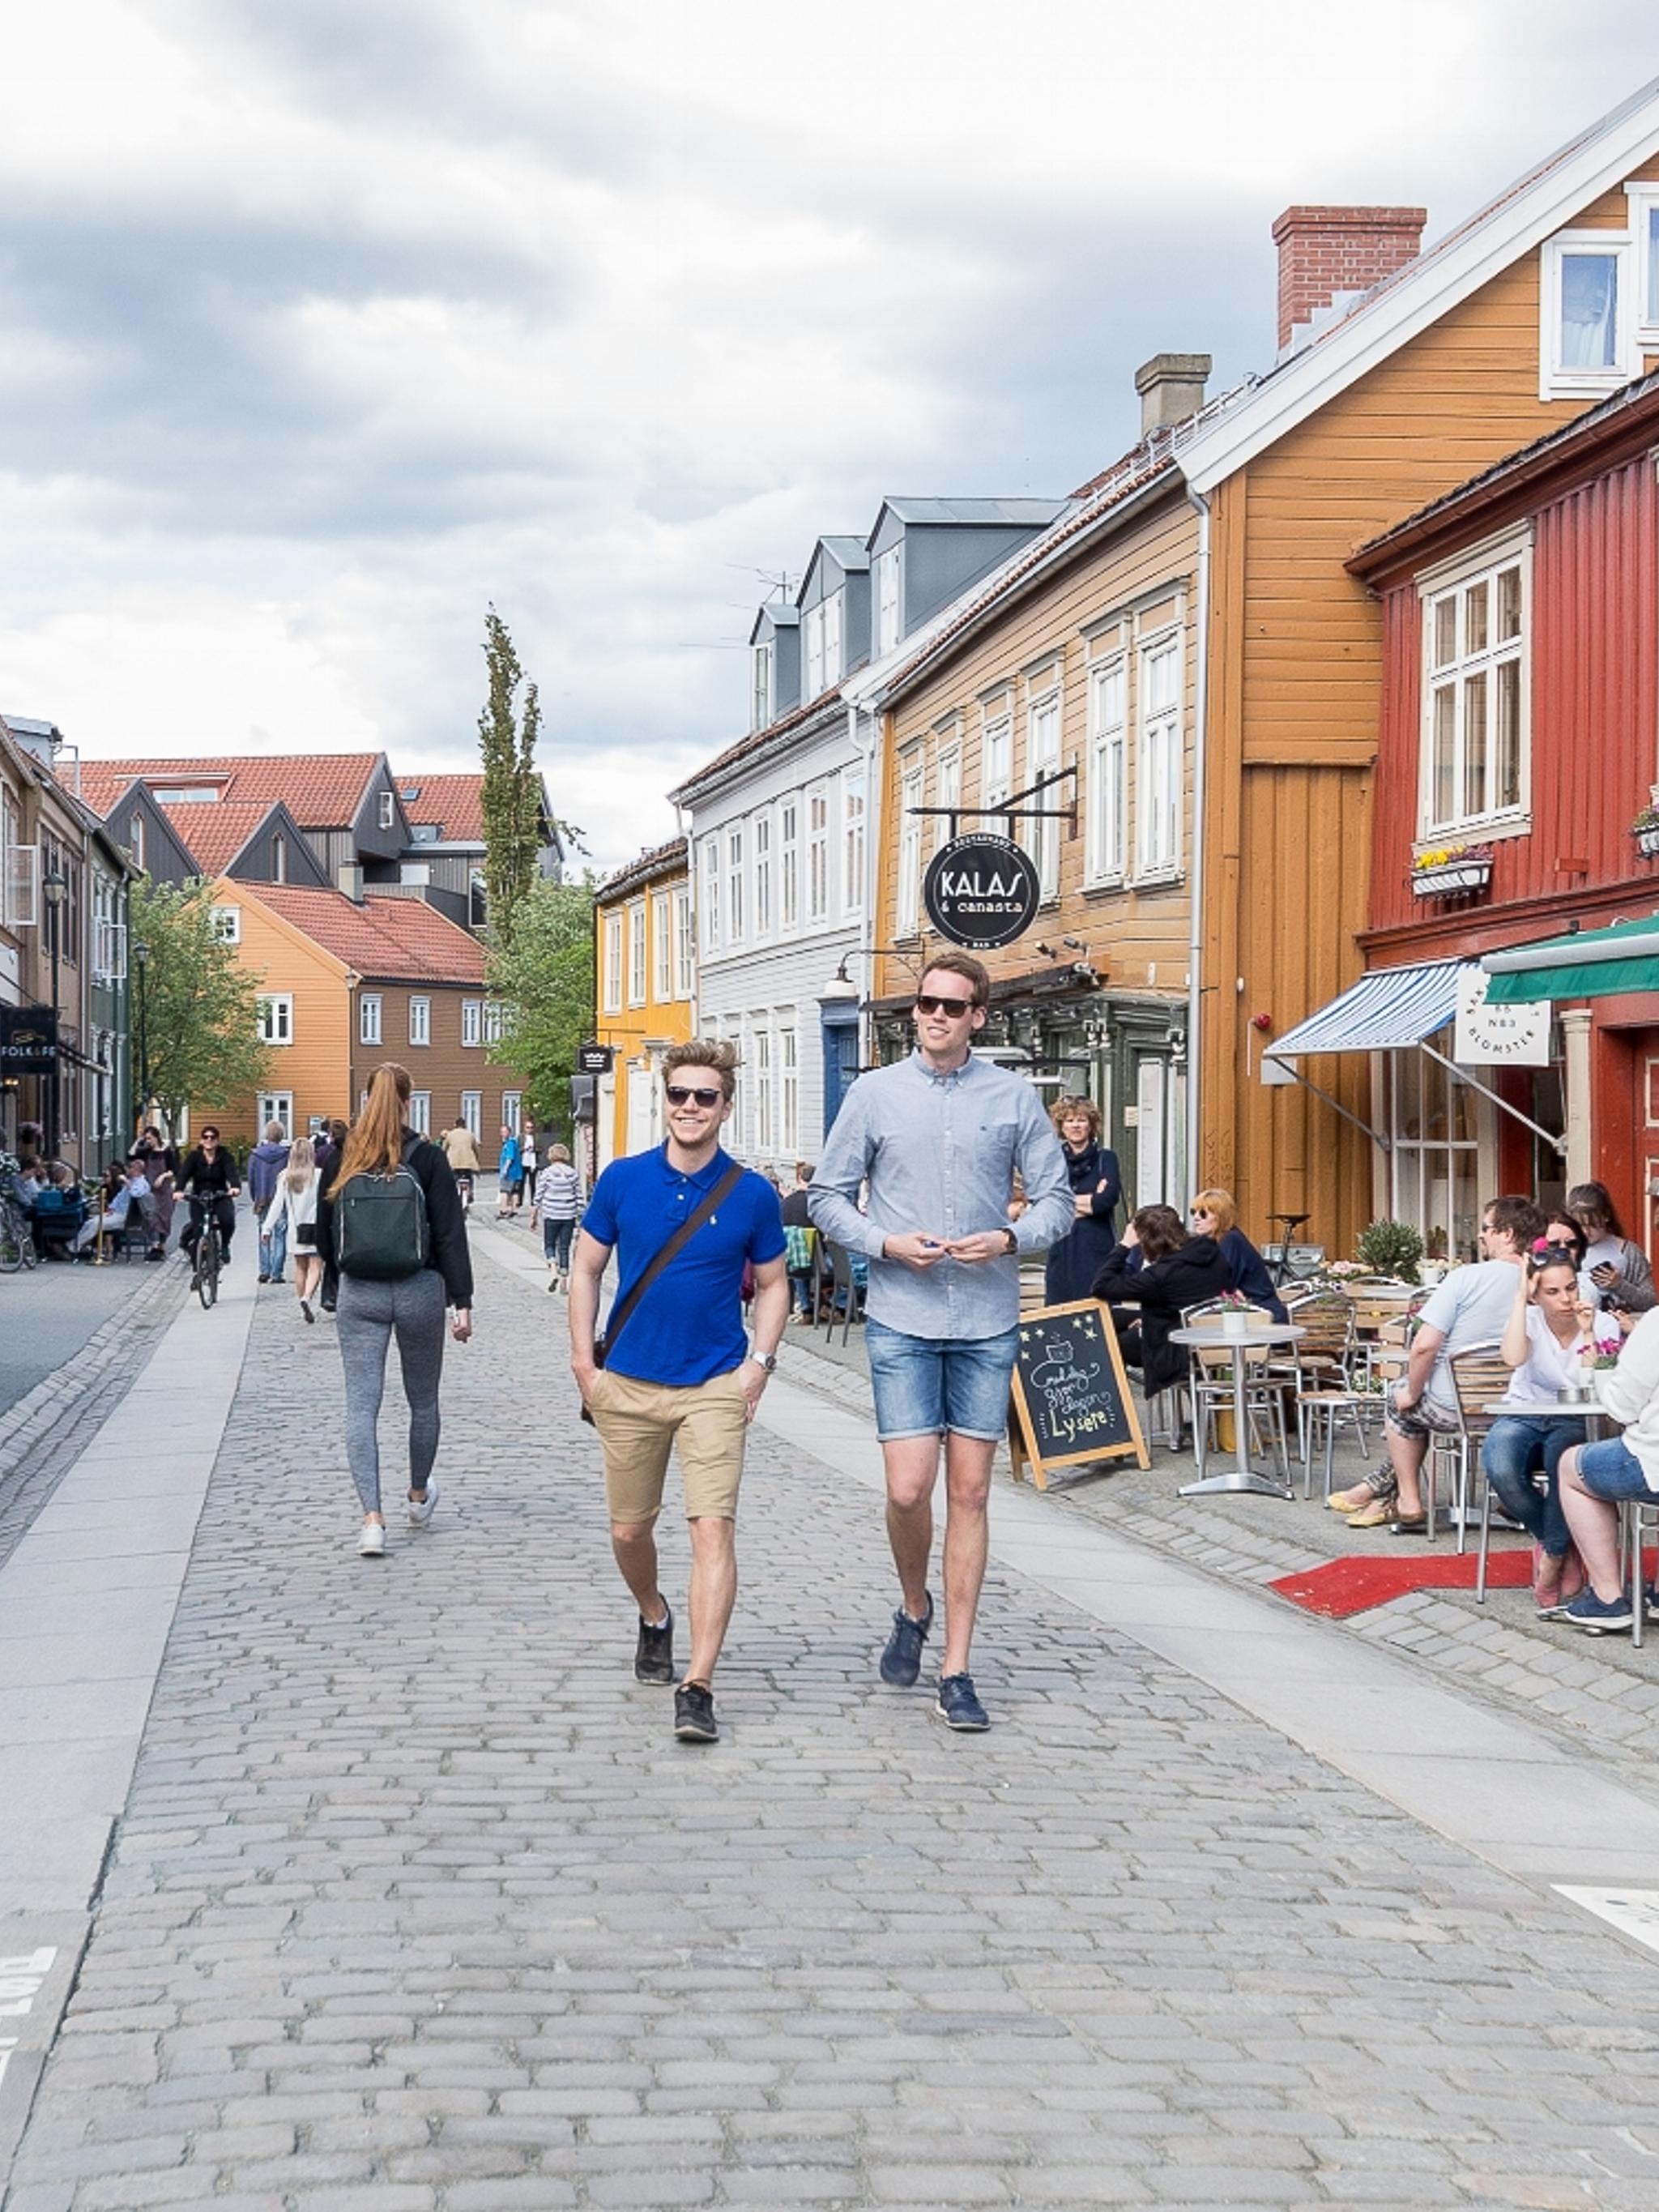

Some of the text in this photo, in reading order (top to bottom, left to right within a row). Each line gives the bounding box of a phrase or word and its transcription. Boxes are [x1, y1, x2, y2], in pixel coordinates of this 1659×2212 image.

[941, 871, 1022, 897] KALAS
[957, 901, 1023, 913] canasta
[1468, 1026, 1534, 1054] BLOMSTER
